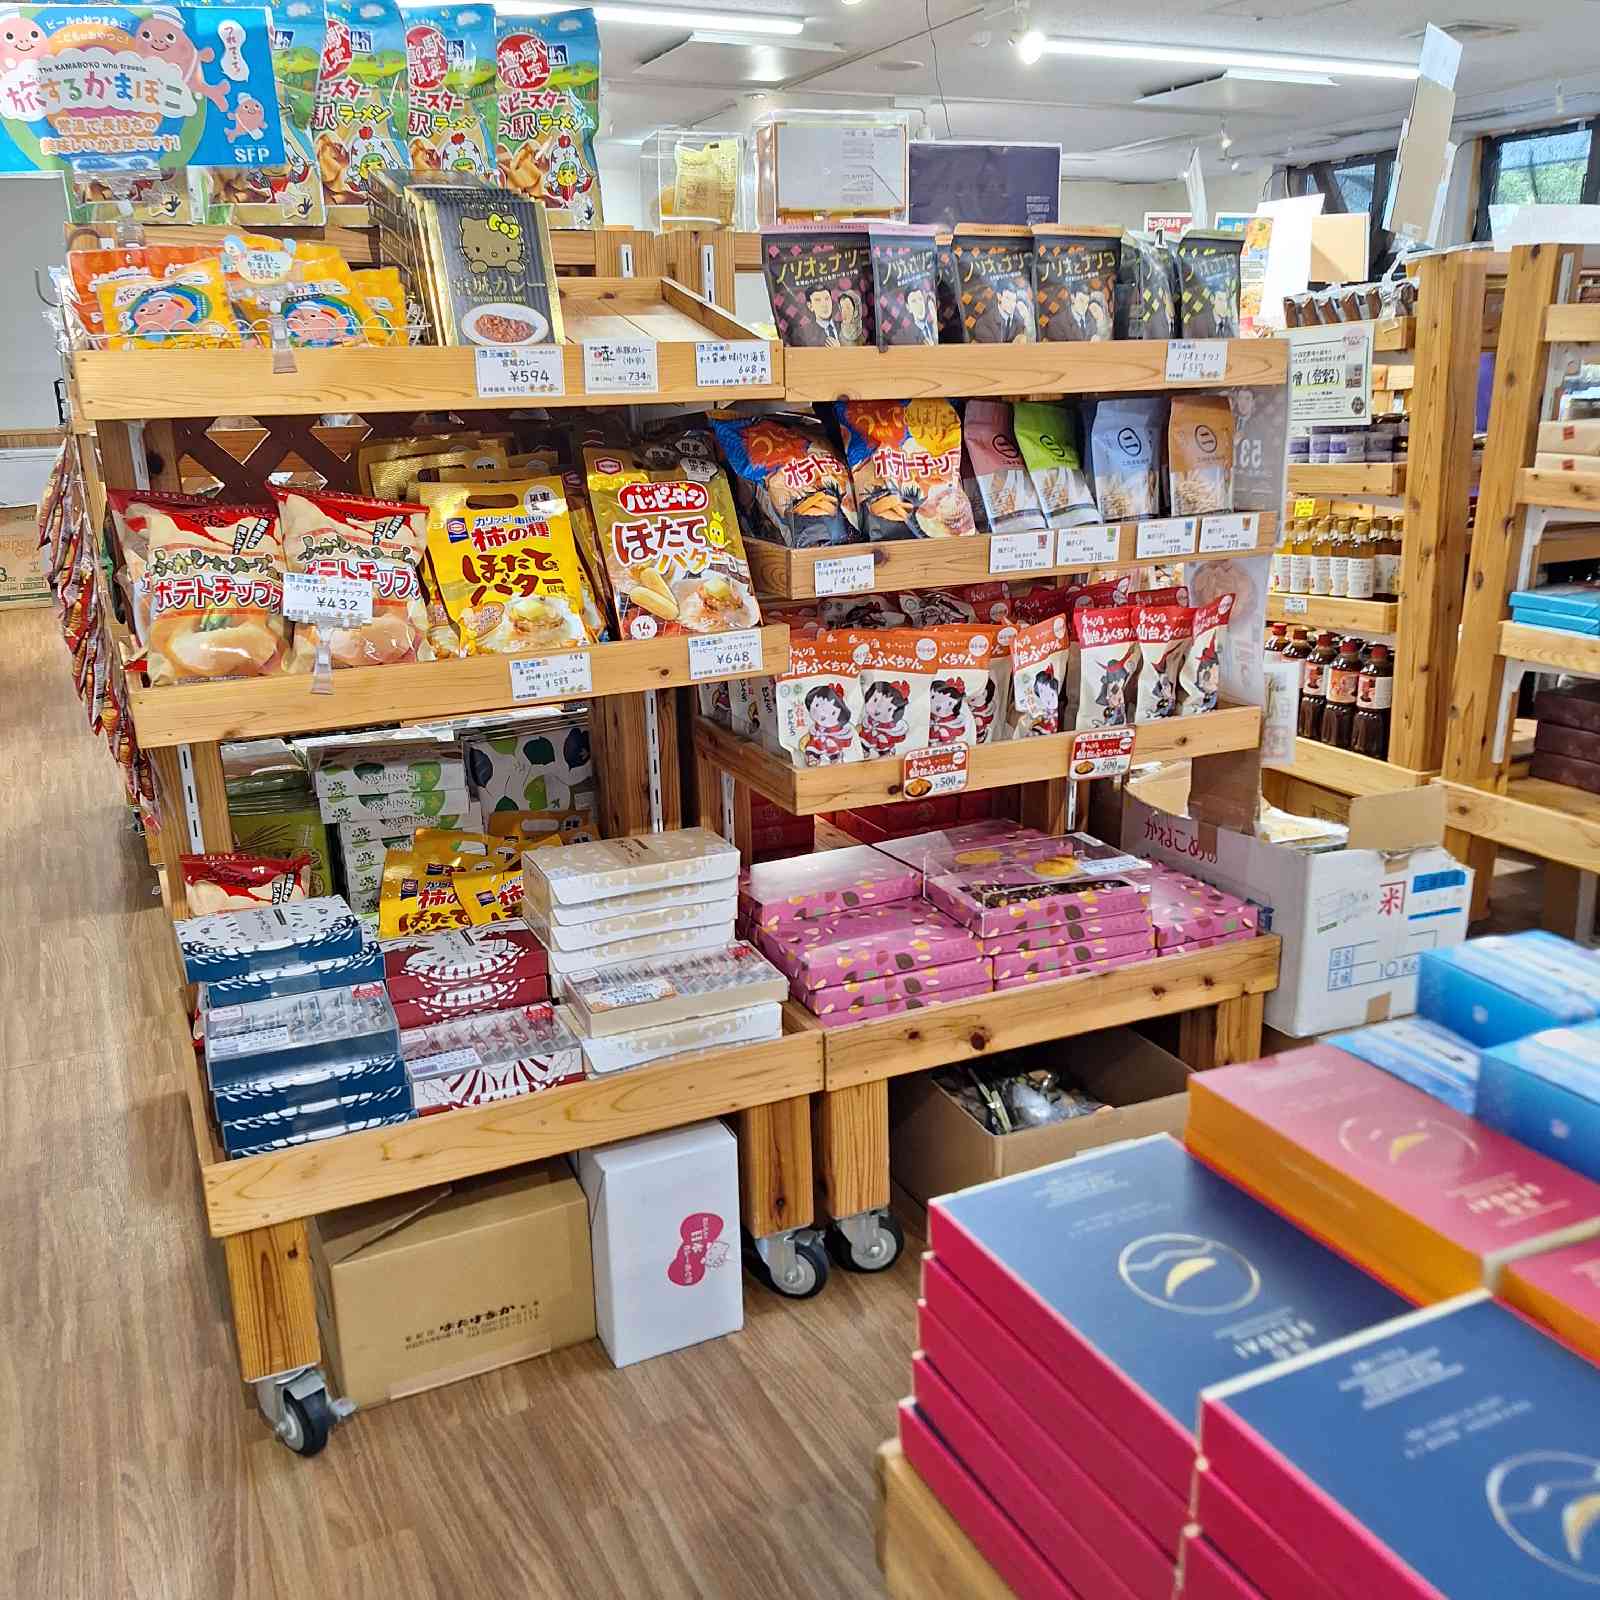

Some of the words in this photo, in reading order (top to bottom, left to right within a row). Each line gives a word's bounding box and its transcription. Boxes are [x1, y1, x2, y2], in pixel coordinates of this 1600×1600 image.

[55, 62, 100, 72] KAMABOKO
[337, 103, 391, 122] ラーメン
[234, 148, 270, 163] SFP
[510, 370, 549, 383] ¥594
[627, 484, 705, 511] ハッピーターン
[471, 521, 551, 553] 柿の種
[614, 516, 705, 564] ほたて
[151, 549, 283, 582] ふかひれスープ
[461, 547, 553, 587] ほたて
[657, 548, 722, 575] バター
[469, 573, 566, 607] バター
[316, 596, 359, 612] ¥432
[716, 653, 750, 664] ¥648
[1379, 886, 1404, 916] 米
